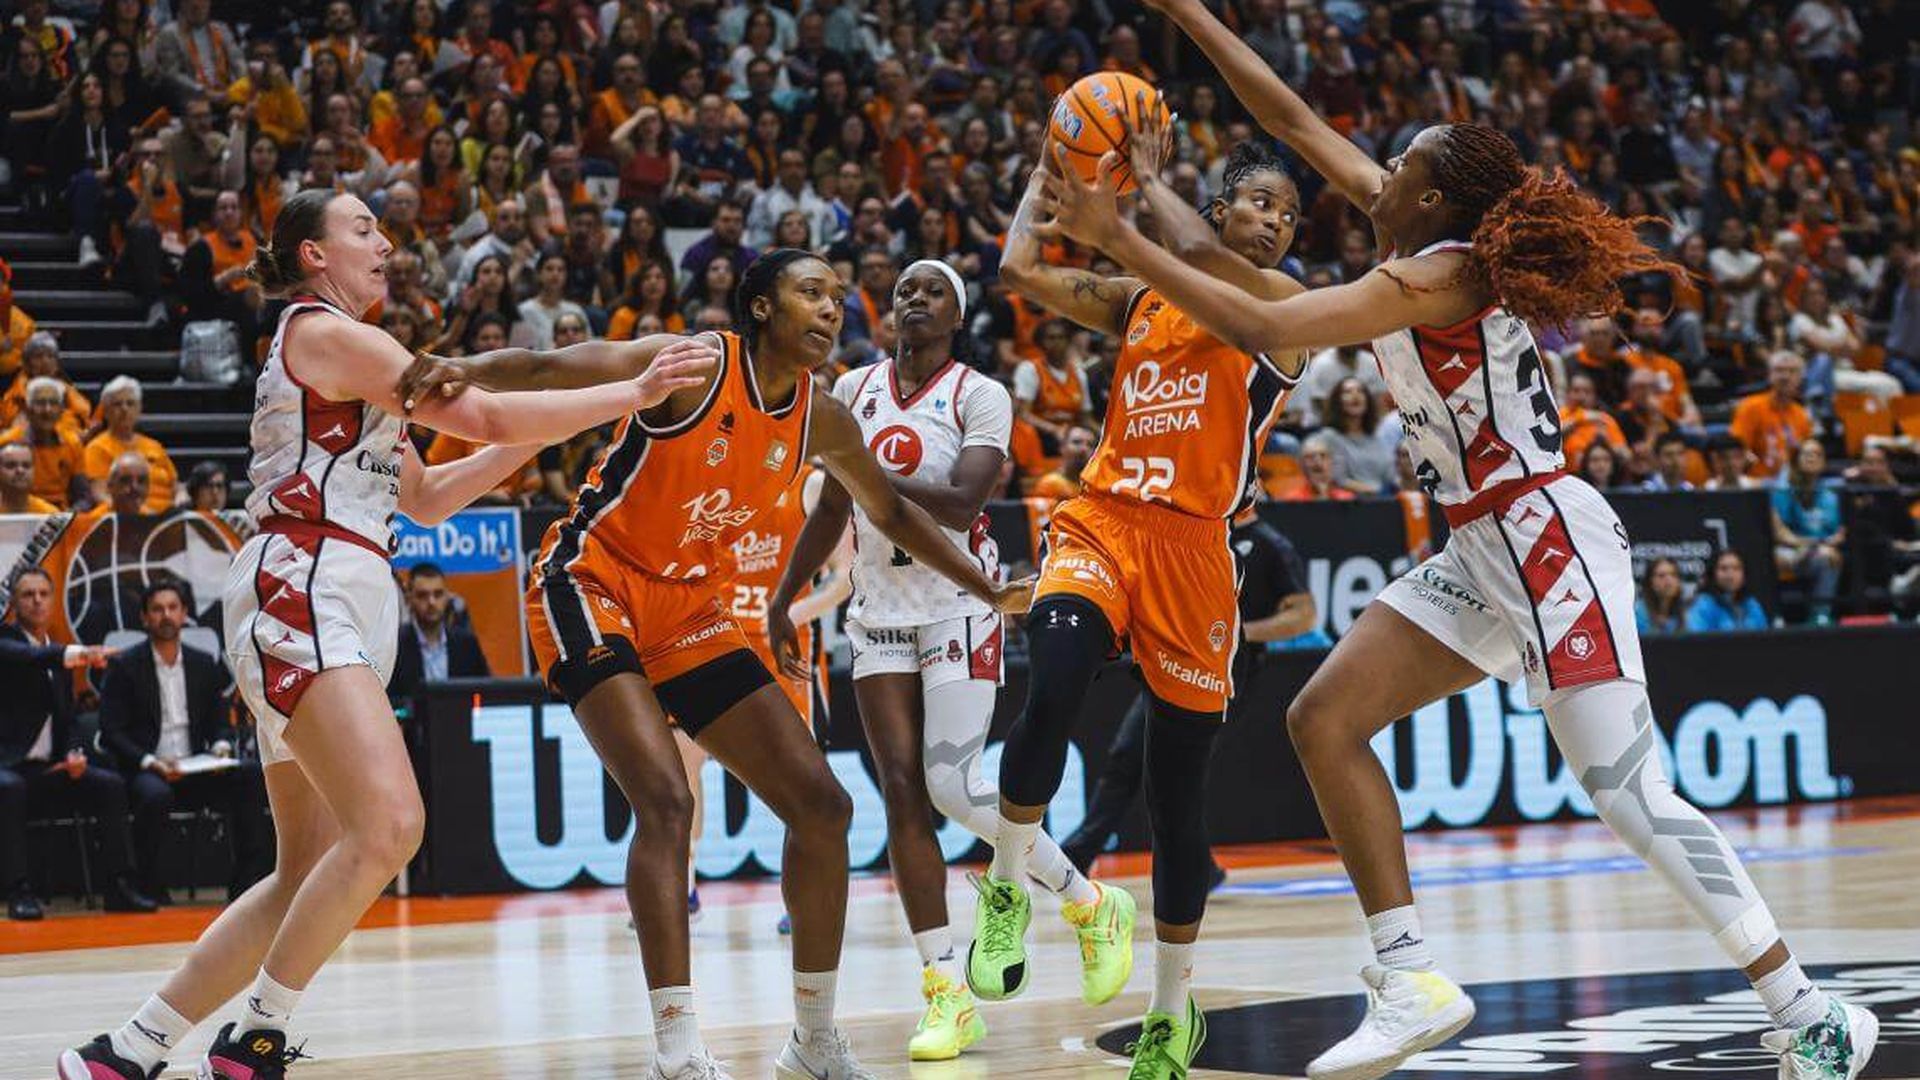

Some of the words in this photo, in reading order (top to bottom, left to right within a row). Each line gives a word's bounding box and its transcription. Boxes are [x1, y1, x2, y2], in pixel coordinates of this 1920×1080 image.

[1121, 361, 1209, 408] Roig
[1124, 409, 1200, 440] ARENA
[1111, 457, 1175, 503] 22
[399, 532, 434, 557] an
[439, 521, 475, 557] Do
[479, 520, 509, 557] It!
[731, 585, 768, 619] 23
[1412, 586, 1461, 615] HOTELES
